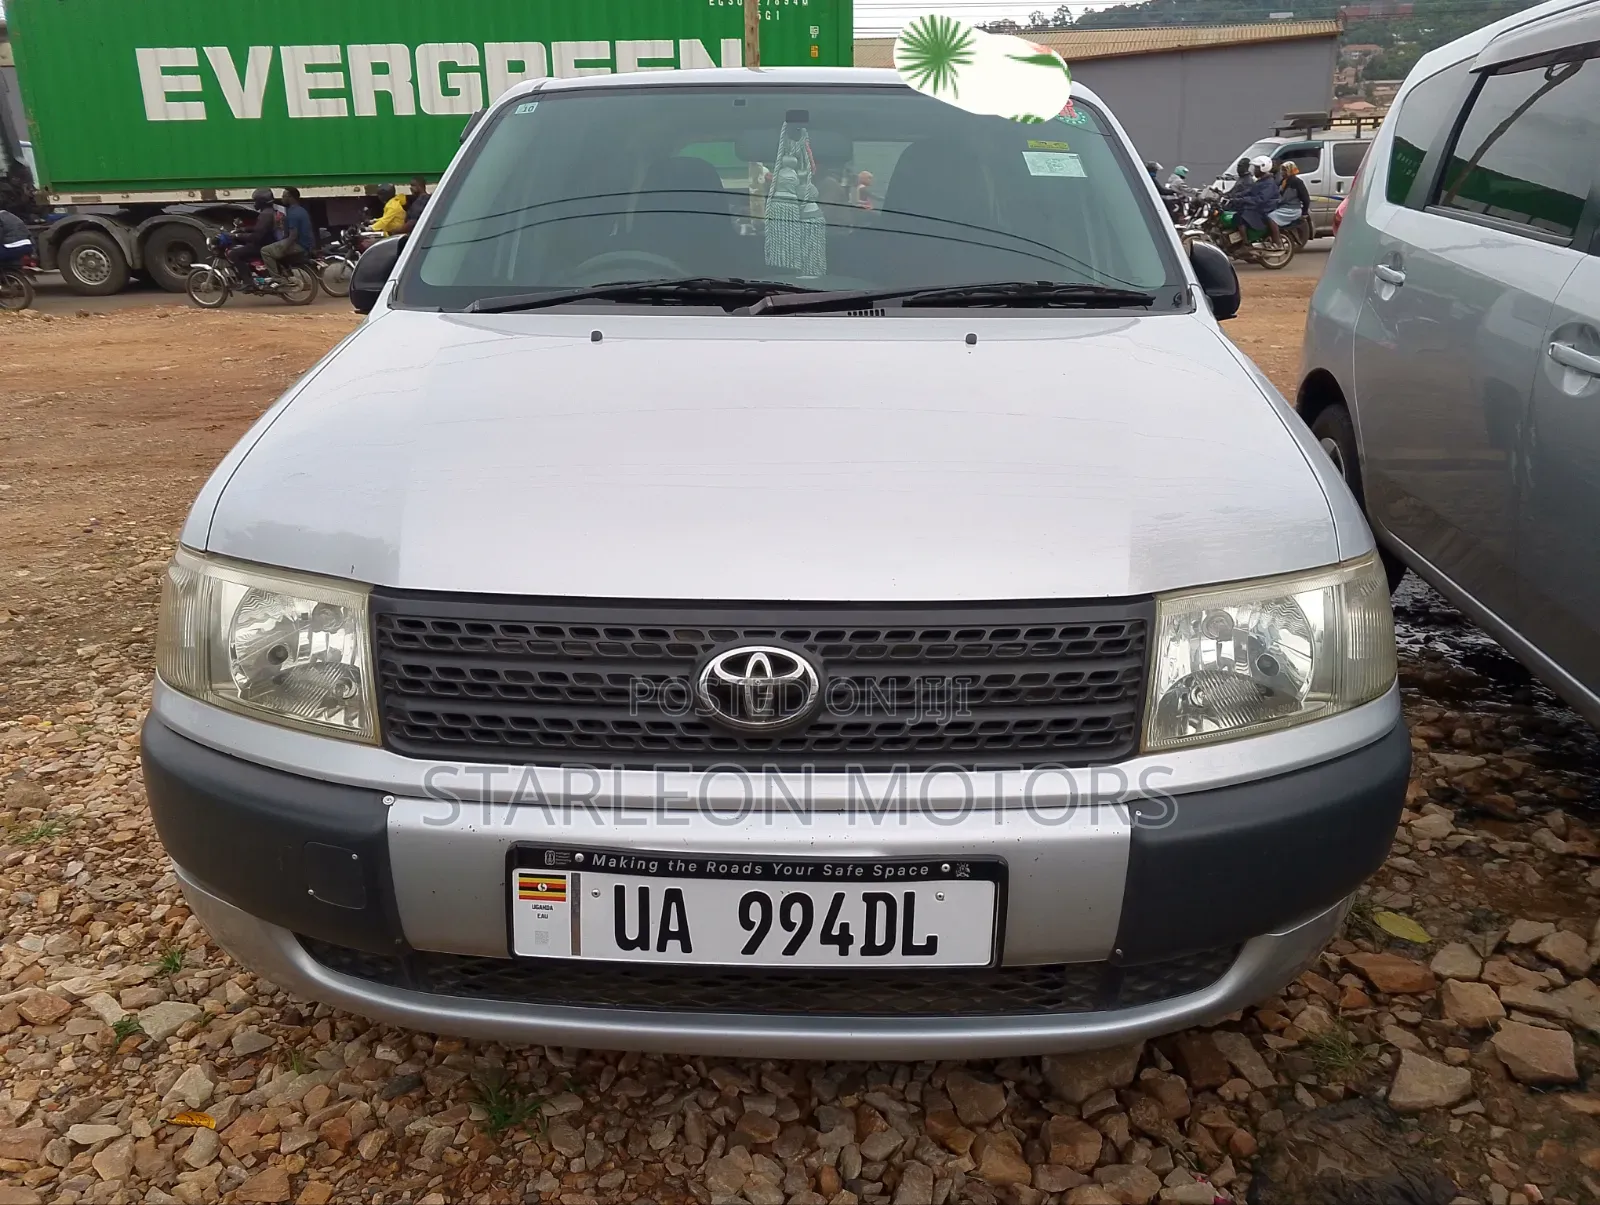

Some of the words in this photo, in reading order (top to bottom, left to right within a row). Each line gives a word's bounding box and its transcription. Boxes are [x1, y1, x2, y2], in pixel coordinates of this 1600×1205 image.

[592, 853, 659, 873] Making
[668, 859, 697, 872] the
[706, 861, 763, 874] Roads
[772, 863, 814, 875] Your
[822, 864, 864, 876] Safe
[872, 864, 930, 878] Space
[614, 885, 692, 953] UA
[738, 890, 939, 956] 994DL
